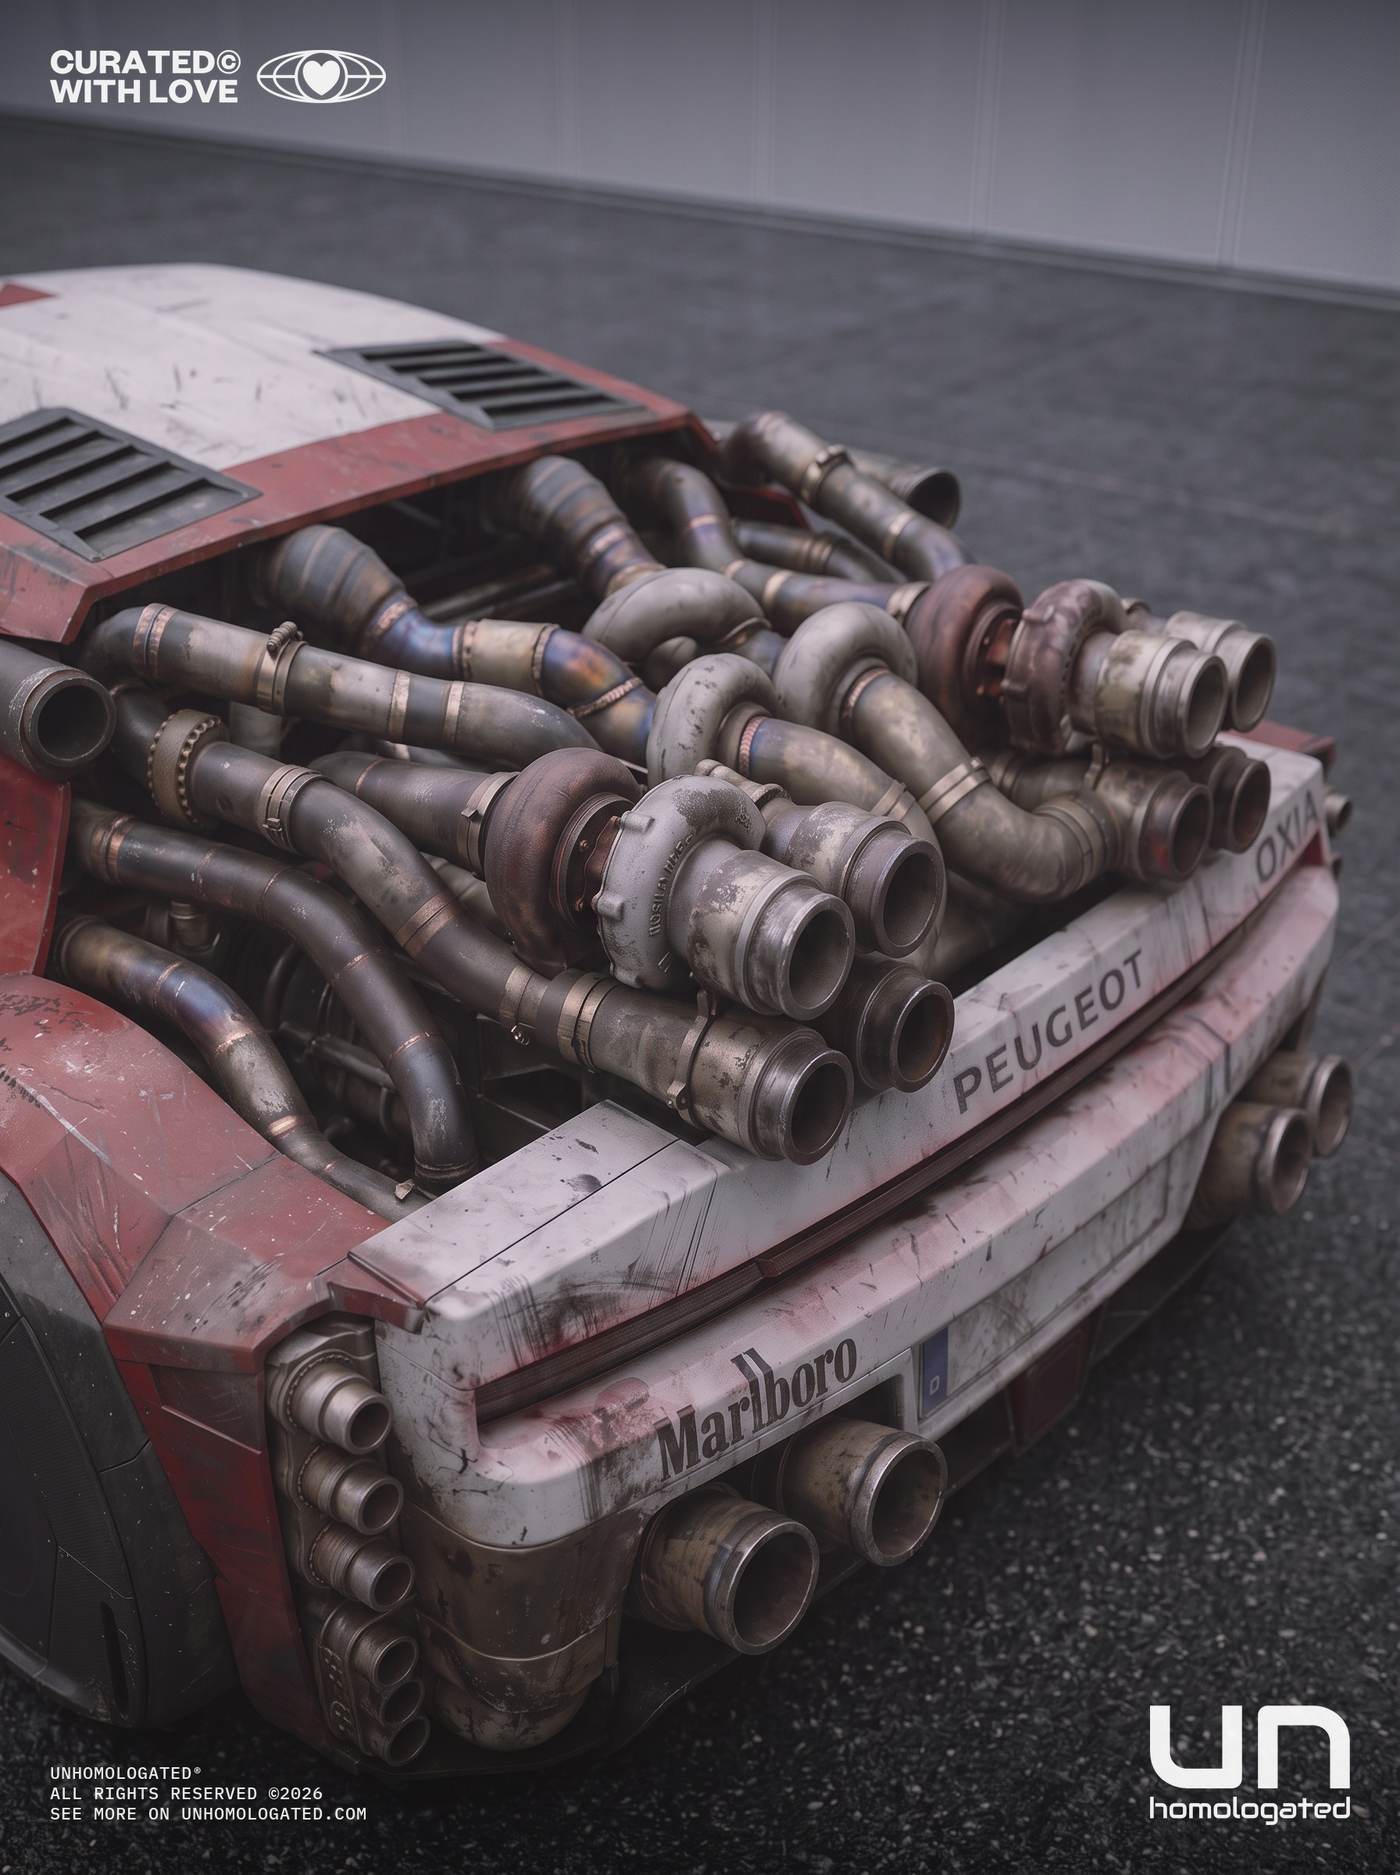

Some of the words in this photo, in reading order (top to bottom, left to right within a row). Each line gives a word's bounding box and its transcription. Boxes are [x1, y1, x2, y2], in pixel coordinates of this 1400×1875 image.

[1255, 789, 1320, 884] OXIA
[951, 949, 1145, 1115] PEUGEOT
[652, 1337, 858, 1482] Marlboro
